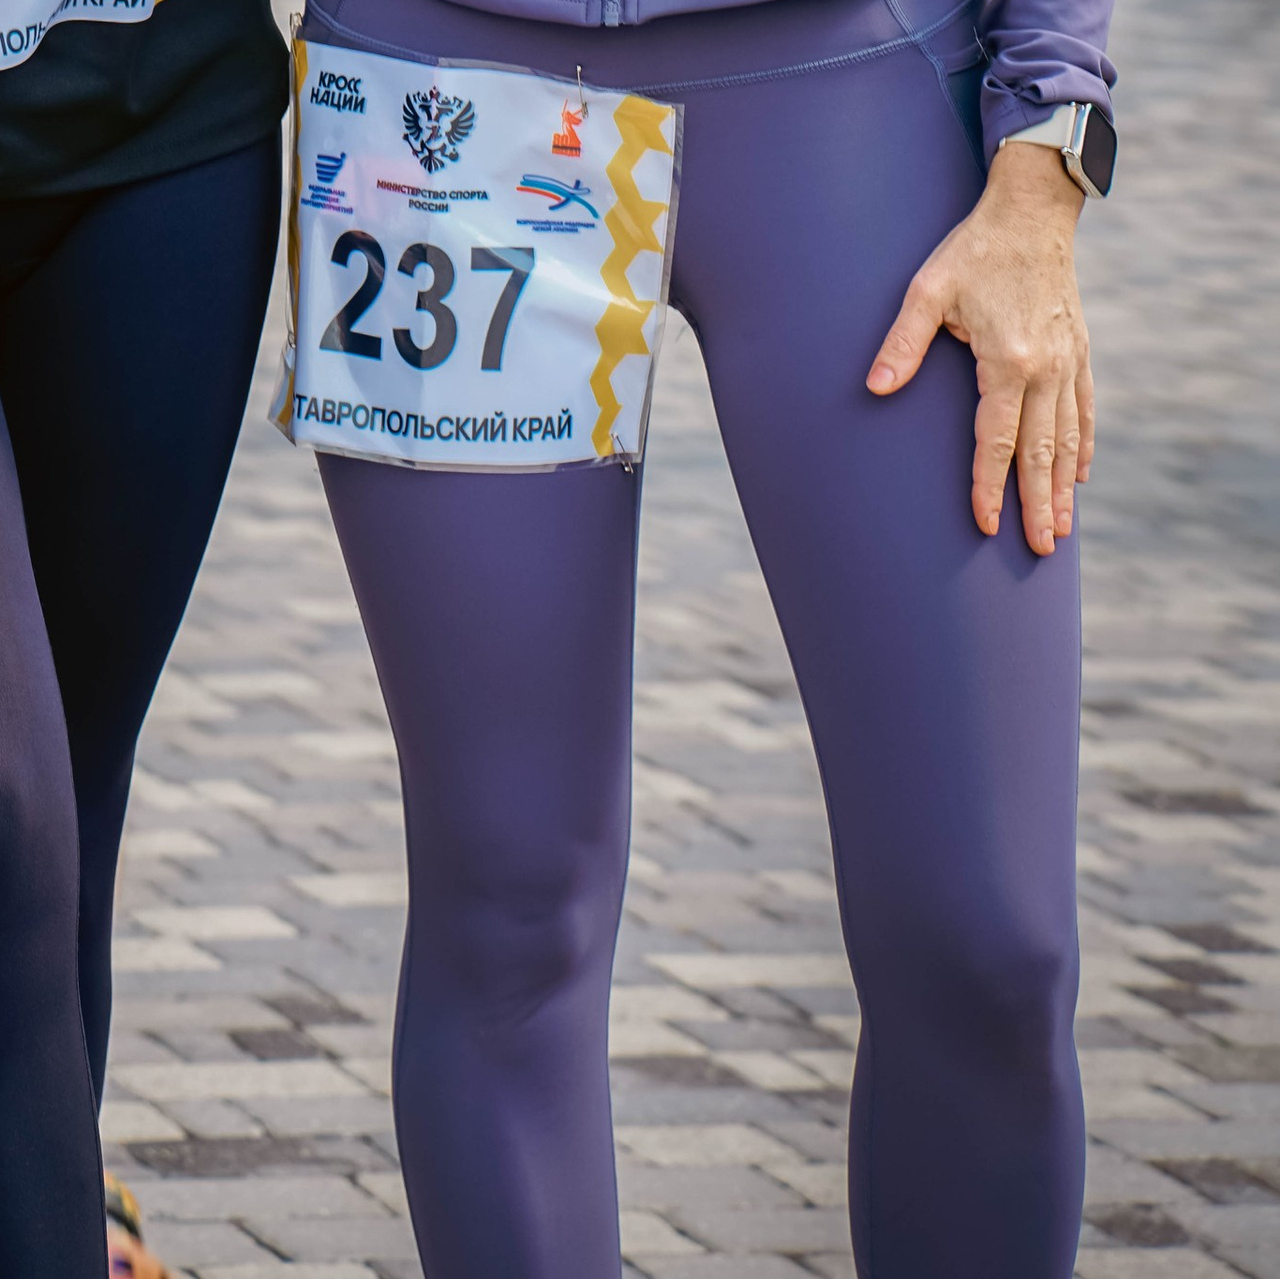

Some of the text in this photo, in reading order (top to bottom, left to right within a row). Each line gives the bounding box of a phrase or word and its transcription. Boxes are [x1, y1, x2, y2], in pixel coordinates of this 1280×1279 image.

[318, 71, 362, 94] КРОСС
[310, 86, 366, 113] НАЦИИ
[376, 179, 489, 200] МИНИСТЕРСТВО СПОРТА
[408, 199, 449, 212] РОССИИ
[318, 229, 536, 372] 237
[293, 393, 573, 441] ТАВРОПОЛЬСКИЙ КРАЙ
